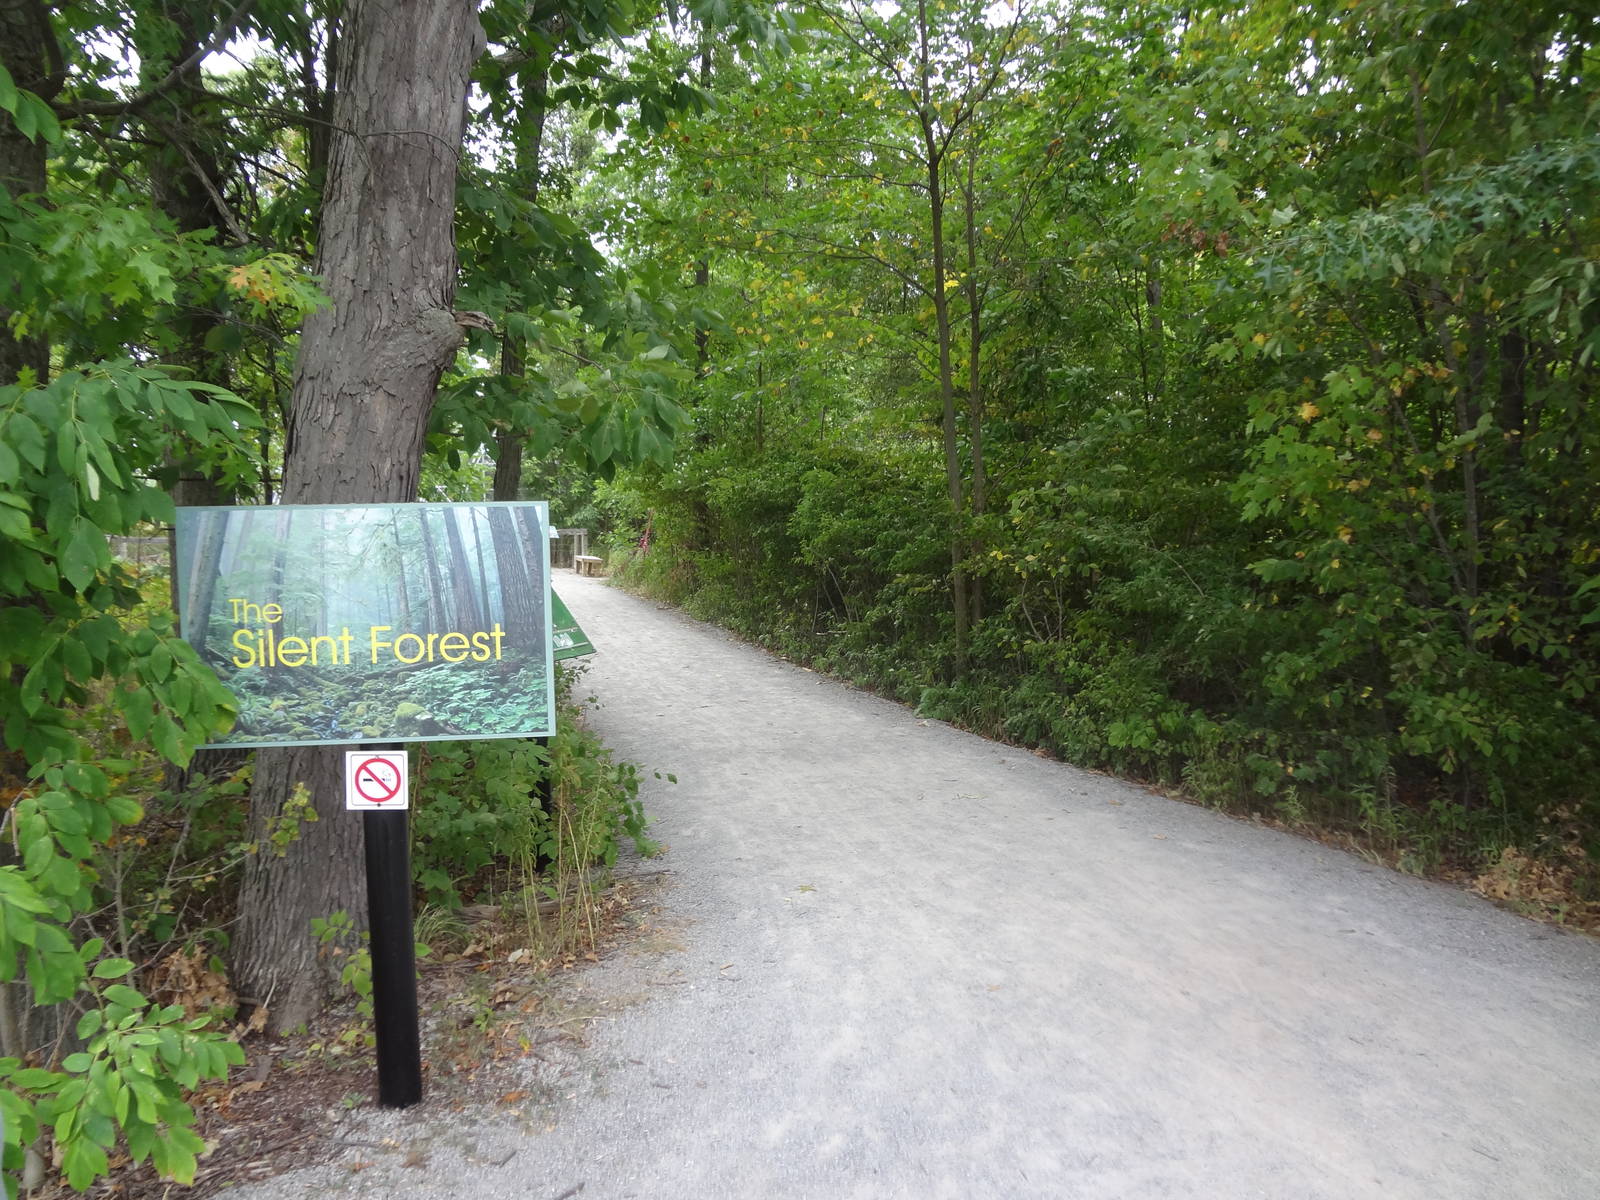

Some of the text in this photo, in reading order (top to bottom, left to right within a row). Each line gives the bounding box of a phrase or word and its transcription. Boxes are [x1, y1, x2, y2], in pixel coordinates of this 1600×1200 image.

[228, 598, 283, 624] The
[232, 623, 506, 668] Silent Forest
